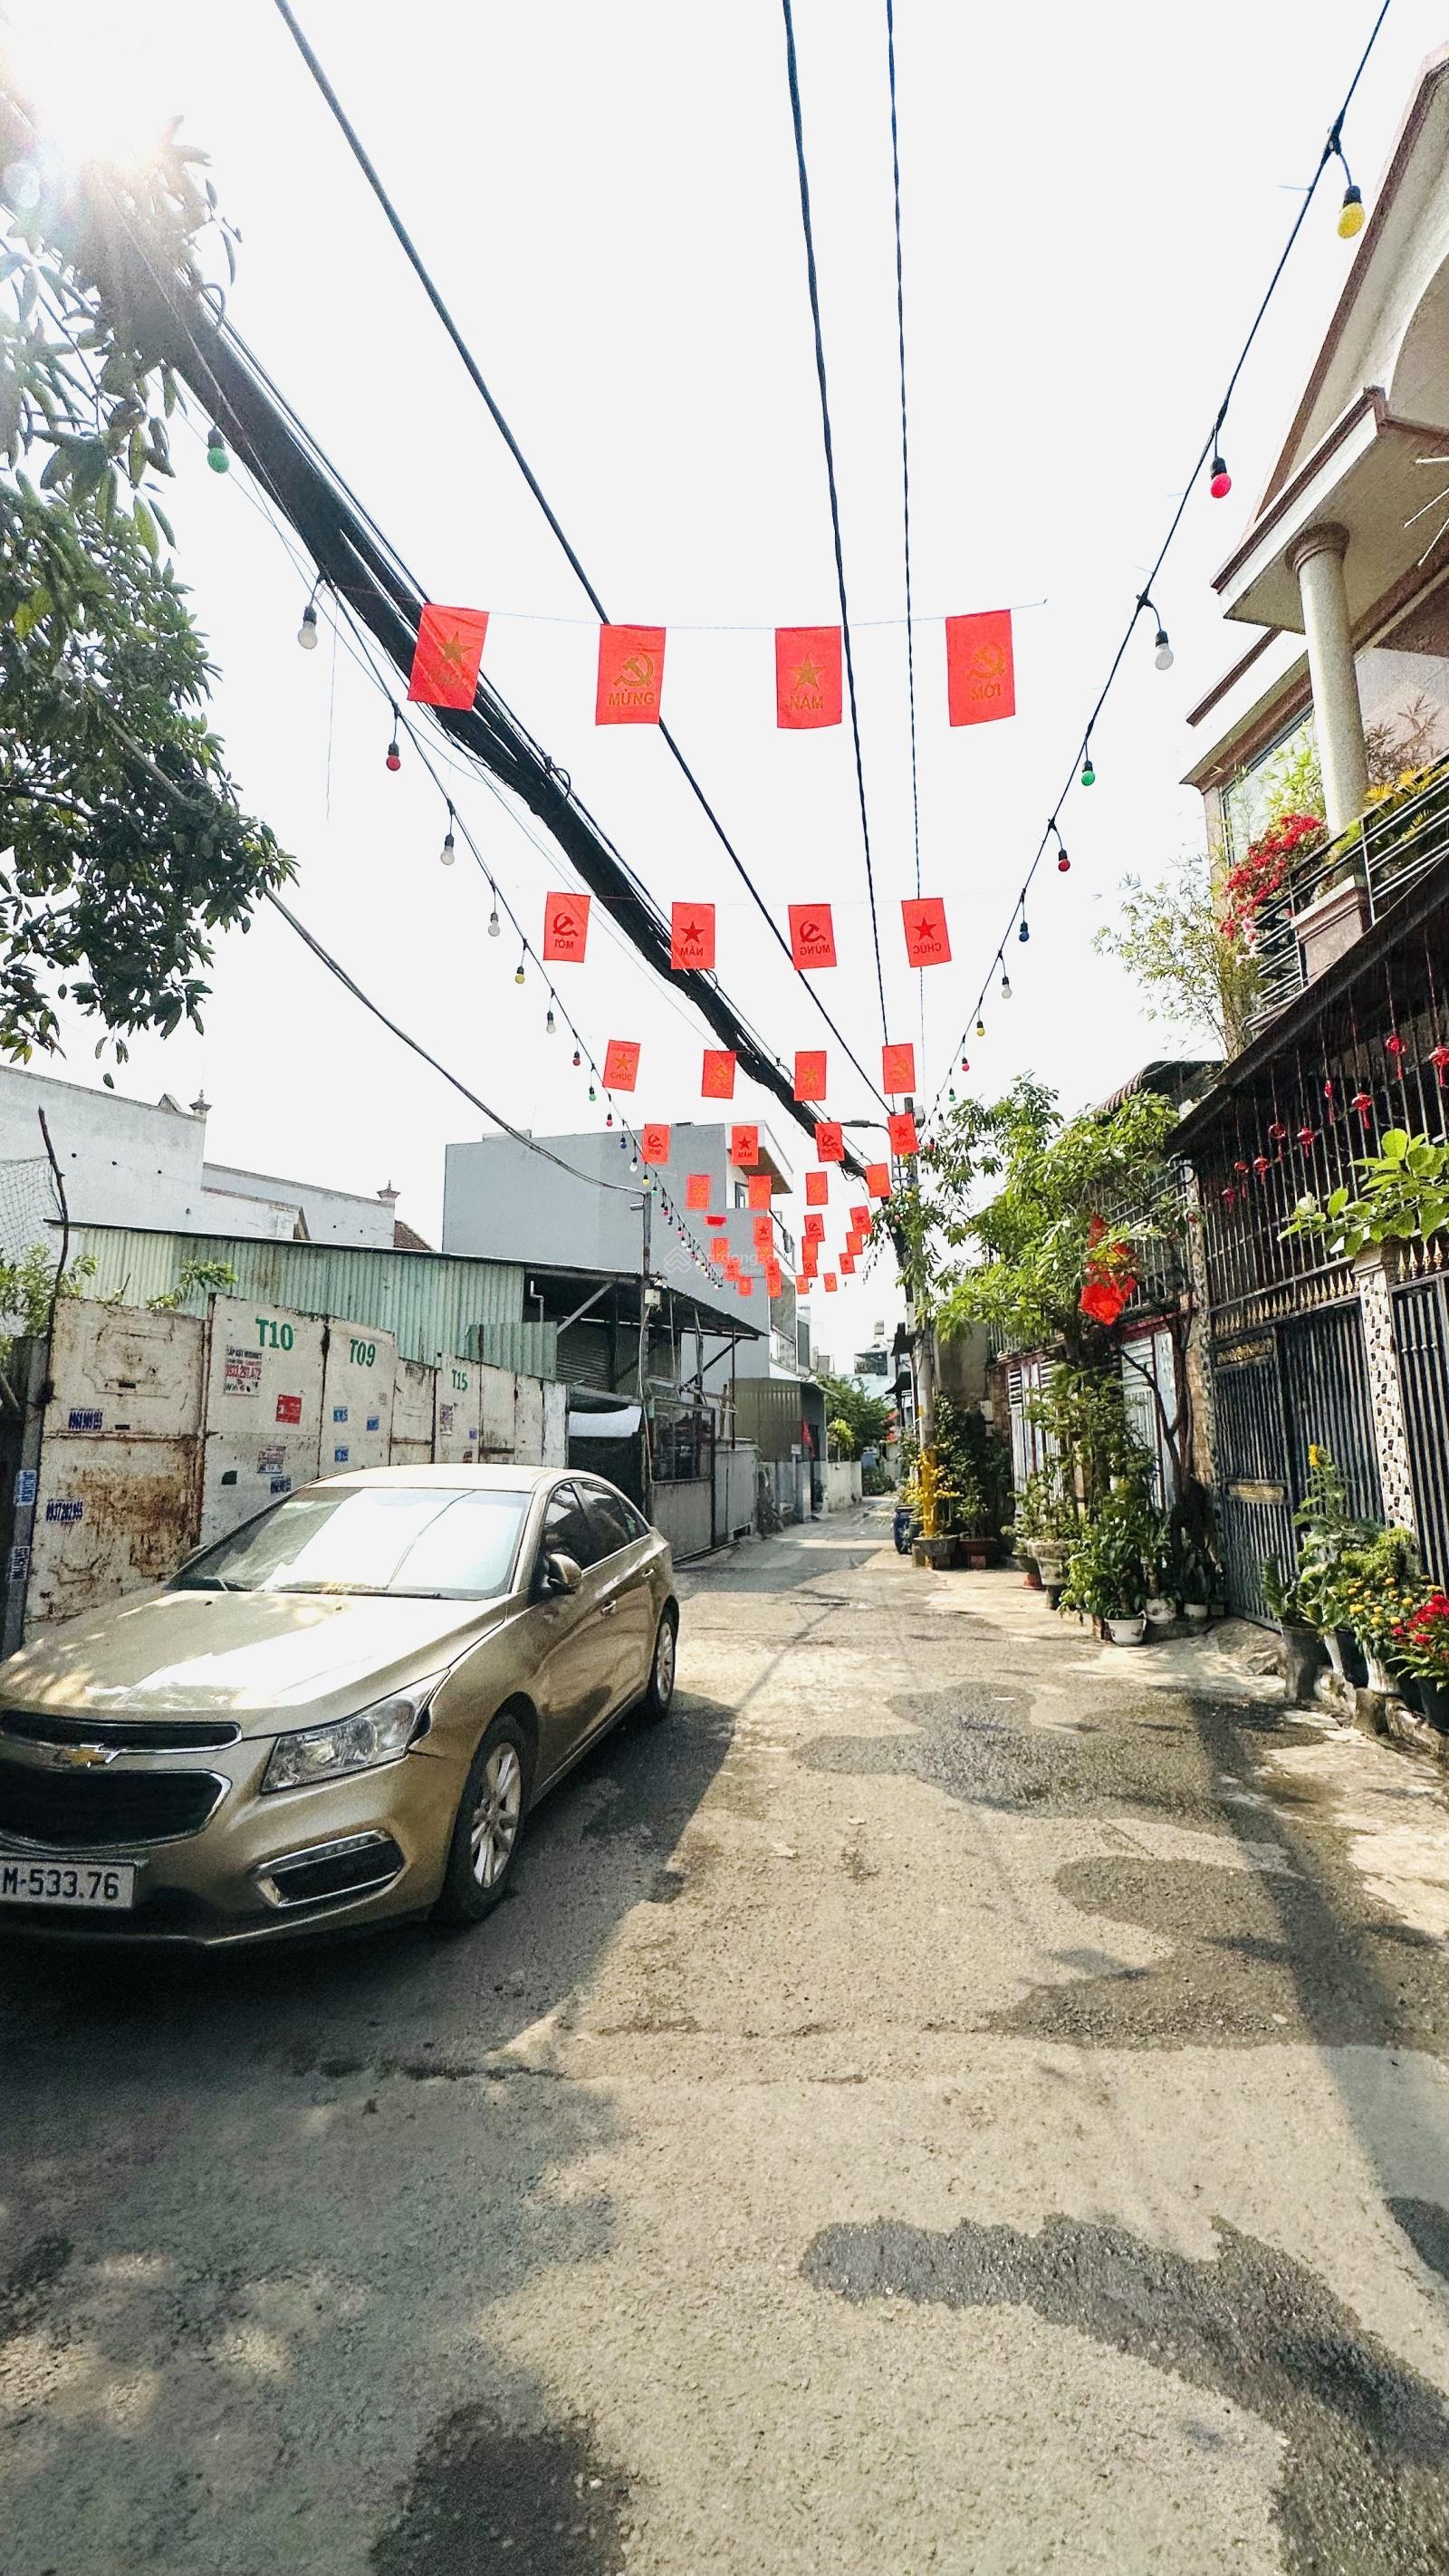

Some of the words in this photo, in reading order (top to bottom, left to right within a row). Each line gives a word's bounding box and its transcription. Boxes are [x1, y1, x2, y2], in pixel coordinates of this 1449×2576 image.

[255, 1318, 294, 1351] T10
[350, 1338, 377, 1368] T09
[452, 1369, 468, 1390] T15
[2, 1866, 119, 1900] M-533.76
